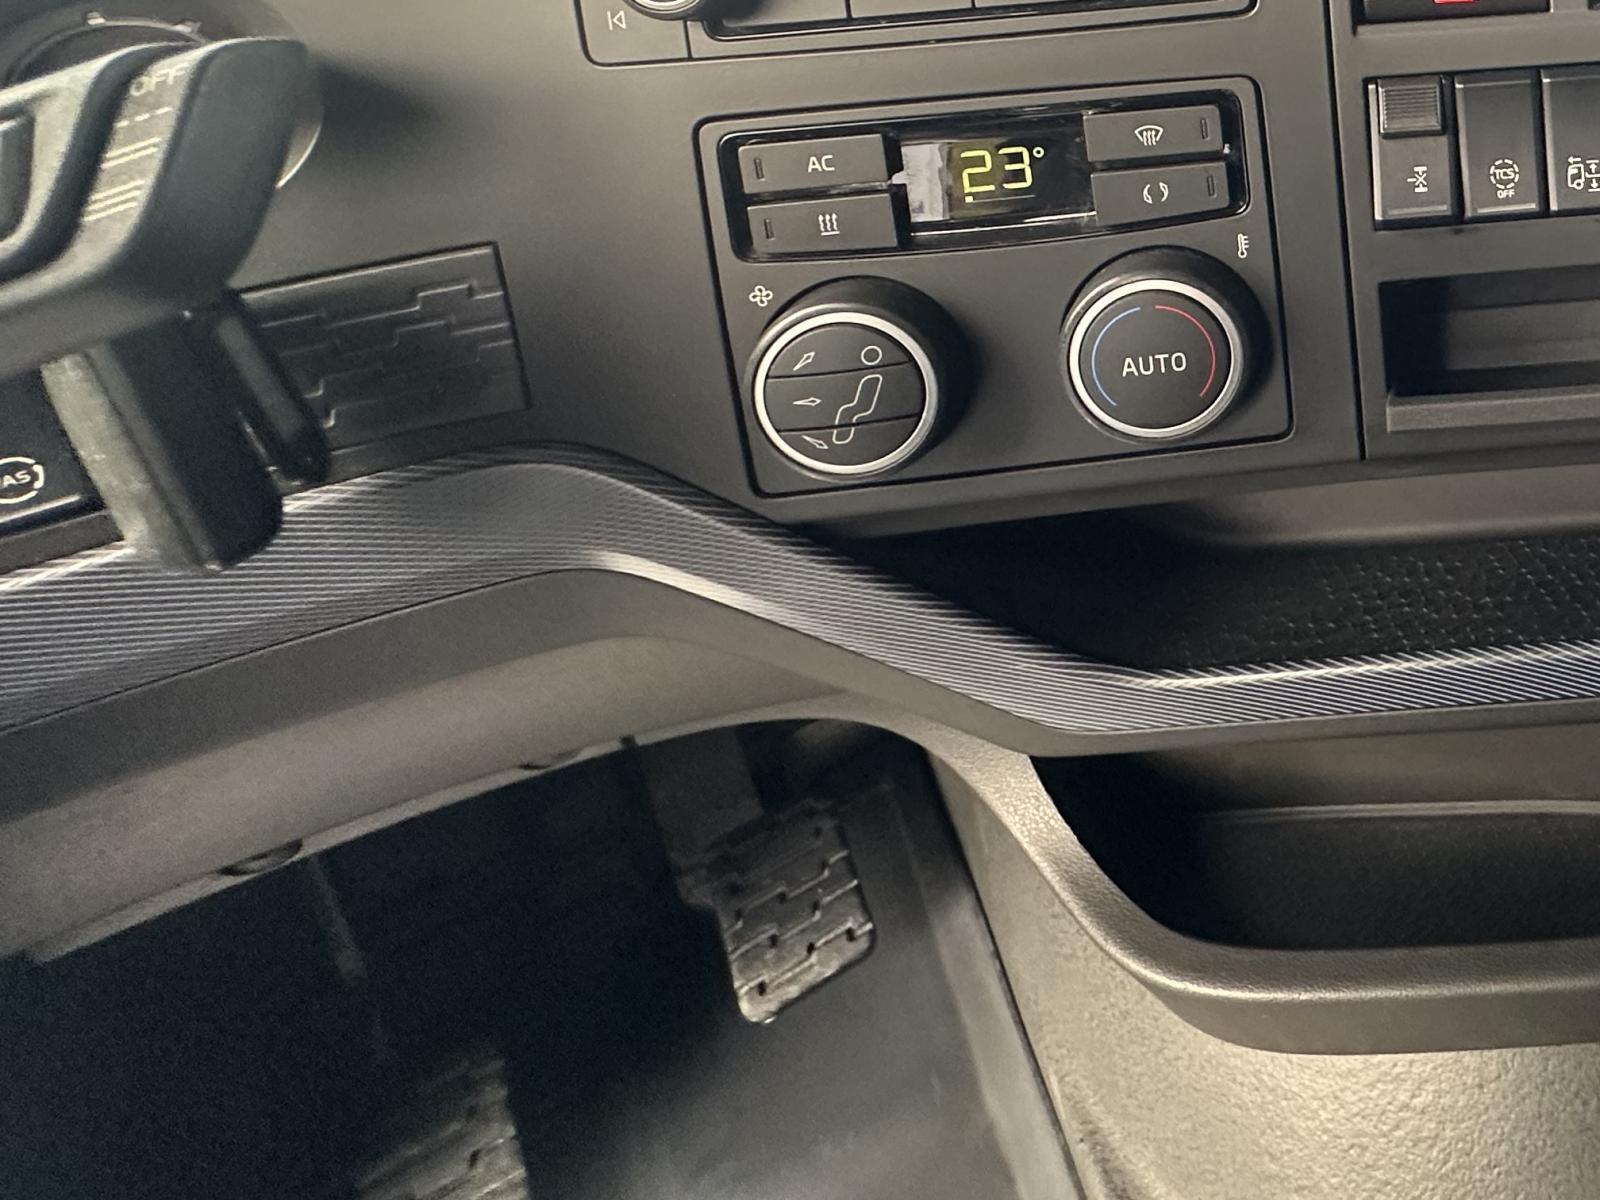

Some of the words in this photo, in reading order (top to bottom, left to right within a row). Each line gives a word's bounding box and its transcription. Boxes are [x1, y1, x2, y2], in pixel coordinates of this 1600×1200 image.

[807, 155, 835, 173] AC
[1494, 168, 1515, 180] TCS
[1497, 189, 1515, 199] OFF
[1122, 352, 1187, 377] AUTO
